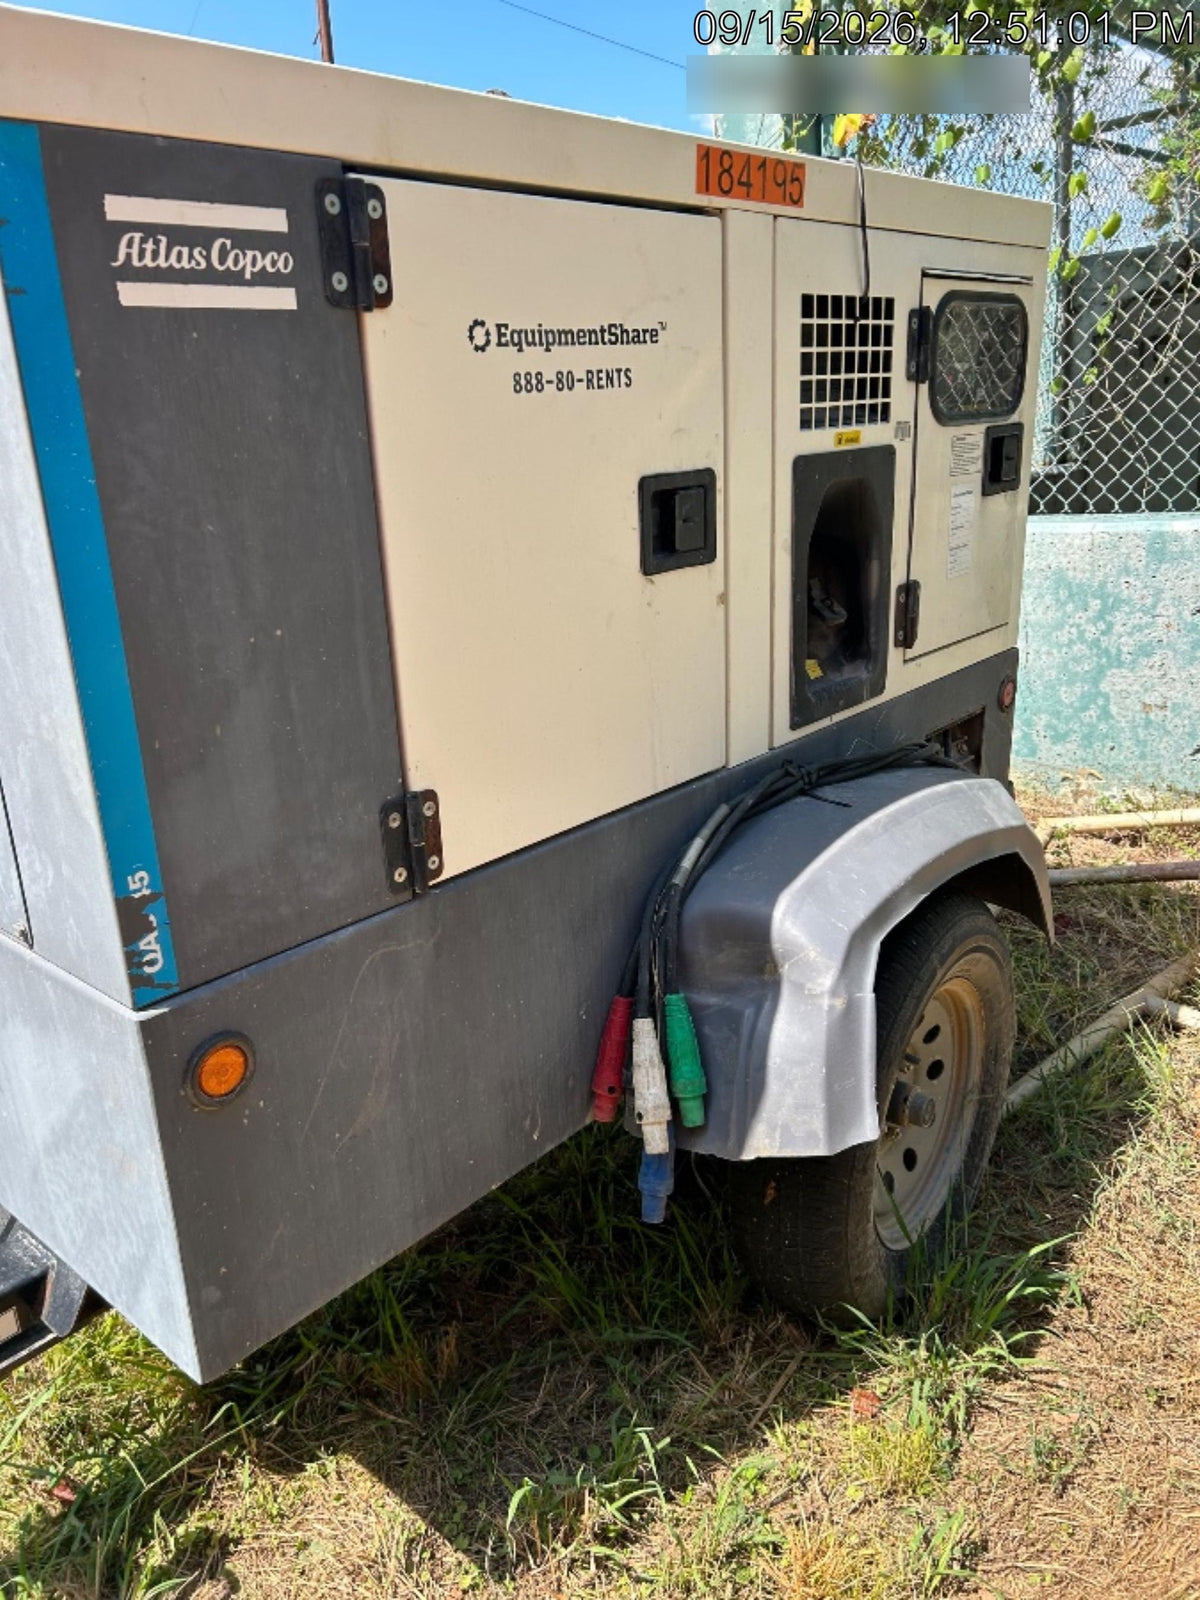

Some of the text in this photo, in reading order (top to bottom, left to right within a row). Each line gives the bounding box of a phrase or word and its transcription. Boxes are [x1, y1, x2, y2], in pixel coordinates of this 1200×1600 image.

[700, 146, 804, 204] 184195
[110, 232, 294, 280] Atlas Copco
[512, 367, 633, 394] 888-80-RENTS
